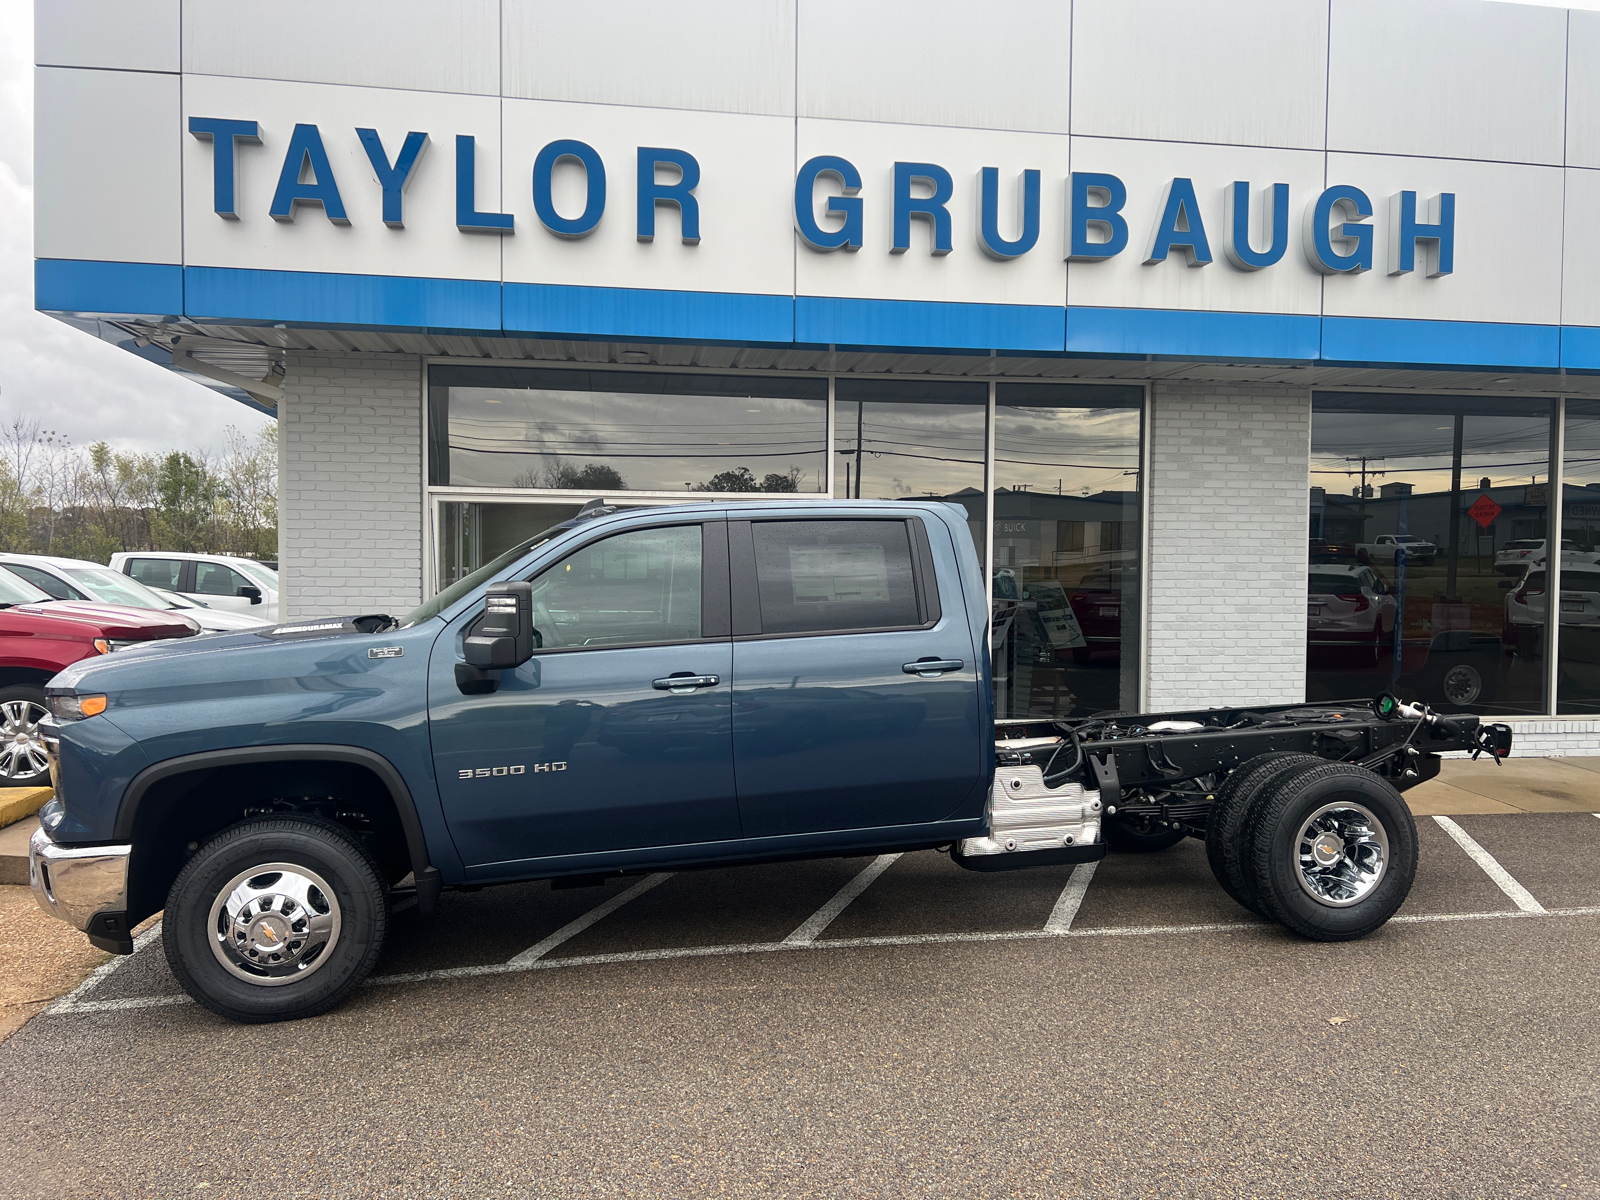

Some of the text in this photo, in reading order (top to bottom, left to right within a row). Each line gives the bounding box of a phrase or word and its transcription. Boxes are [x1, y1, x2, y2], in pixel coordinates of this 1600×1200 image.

[188, 116, 1455, 278] TAYLOR GRUBAUGH
[1004, 522, 1026, 532] BUICK
[300, 622, 343, 632] DURAMAX
[458, 761, 568, 779] 3500 HD
